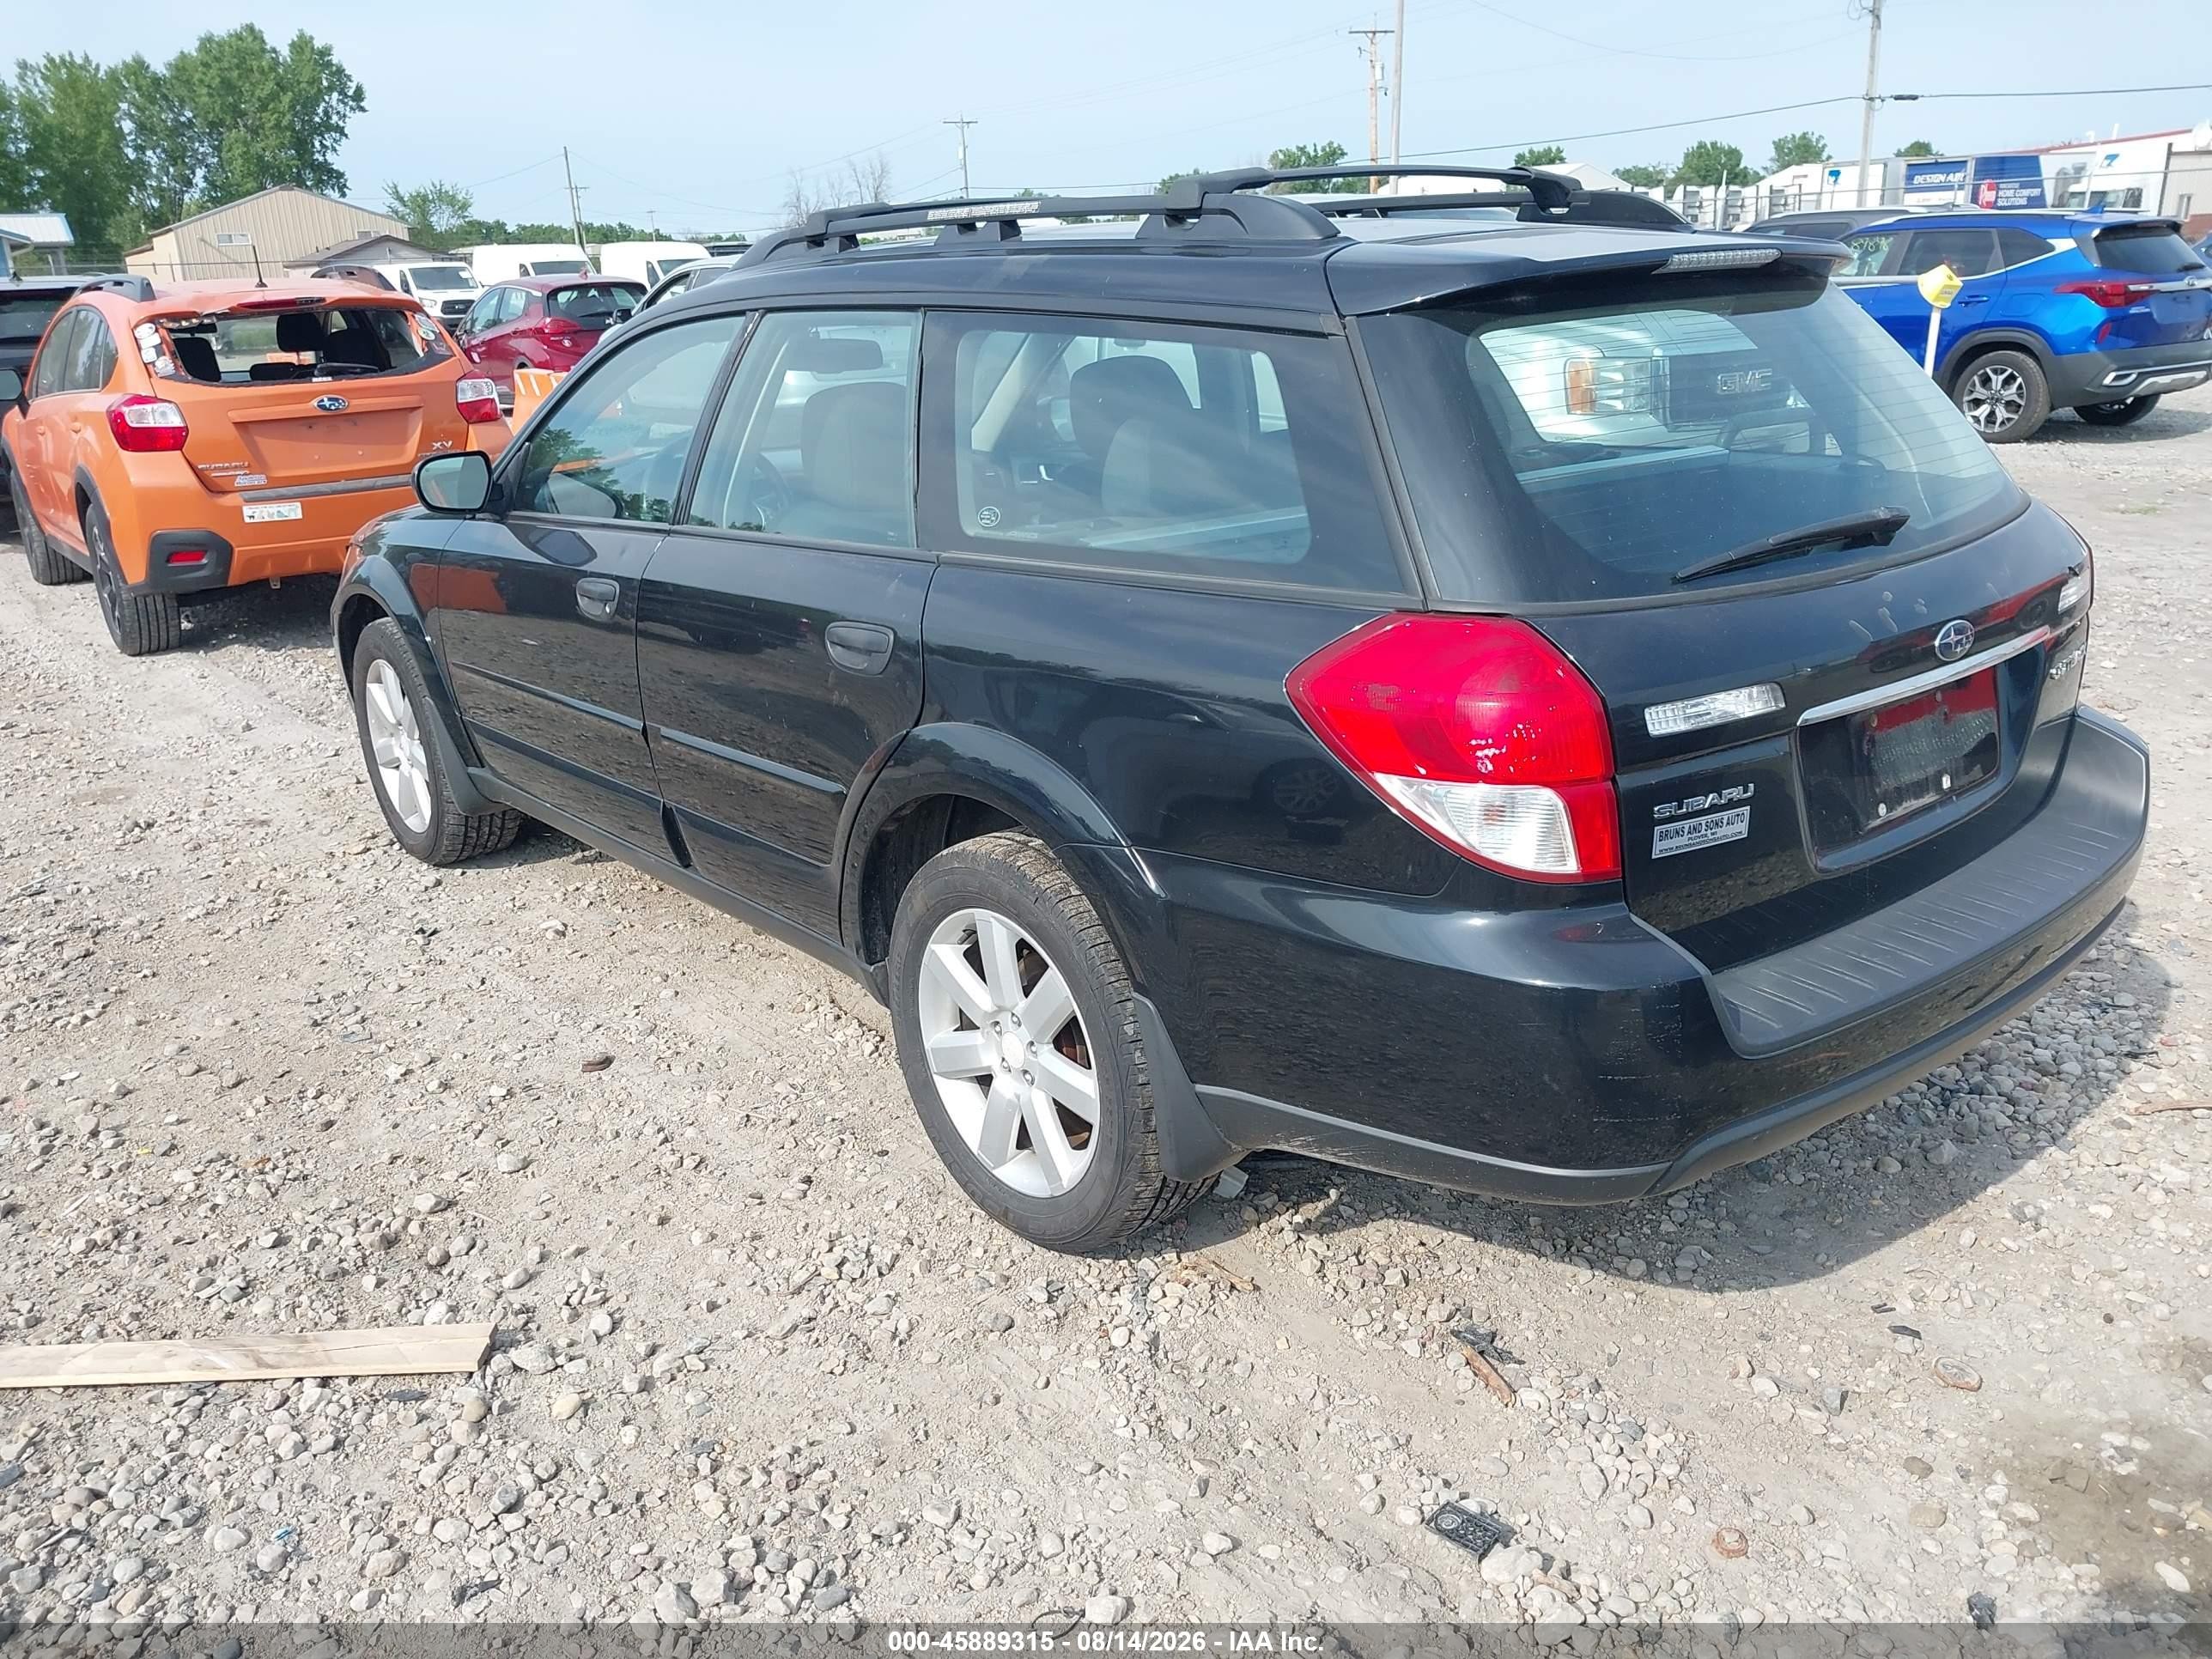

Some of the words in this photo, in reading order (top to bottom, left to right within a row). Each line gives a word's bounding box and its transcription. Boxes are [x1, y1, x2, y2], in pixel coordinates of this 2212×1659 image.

[1913, 173, 1947, 185] DESIGN
[1998, 189, 2015, 198] HOME
[1997, 197, 2028, 207] SOLUTIONS
[1717, 368, 1773, 395] GMC
[432, 440, 453, 451] XV
[1653, 782, 1754, 819] SUBARU
[1658, 826, 1685, 842] BRUNS
[1686, 823, 1703, 836] AND
[1705, 817, 1725, 832] SONS
[1725, 811, 1746, 828] AUTO
